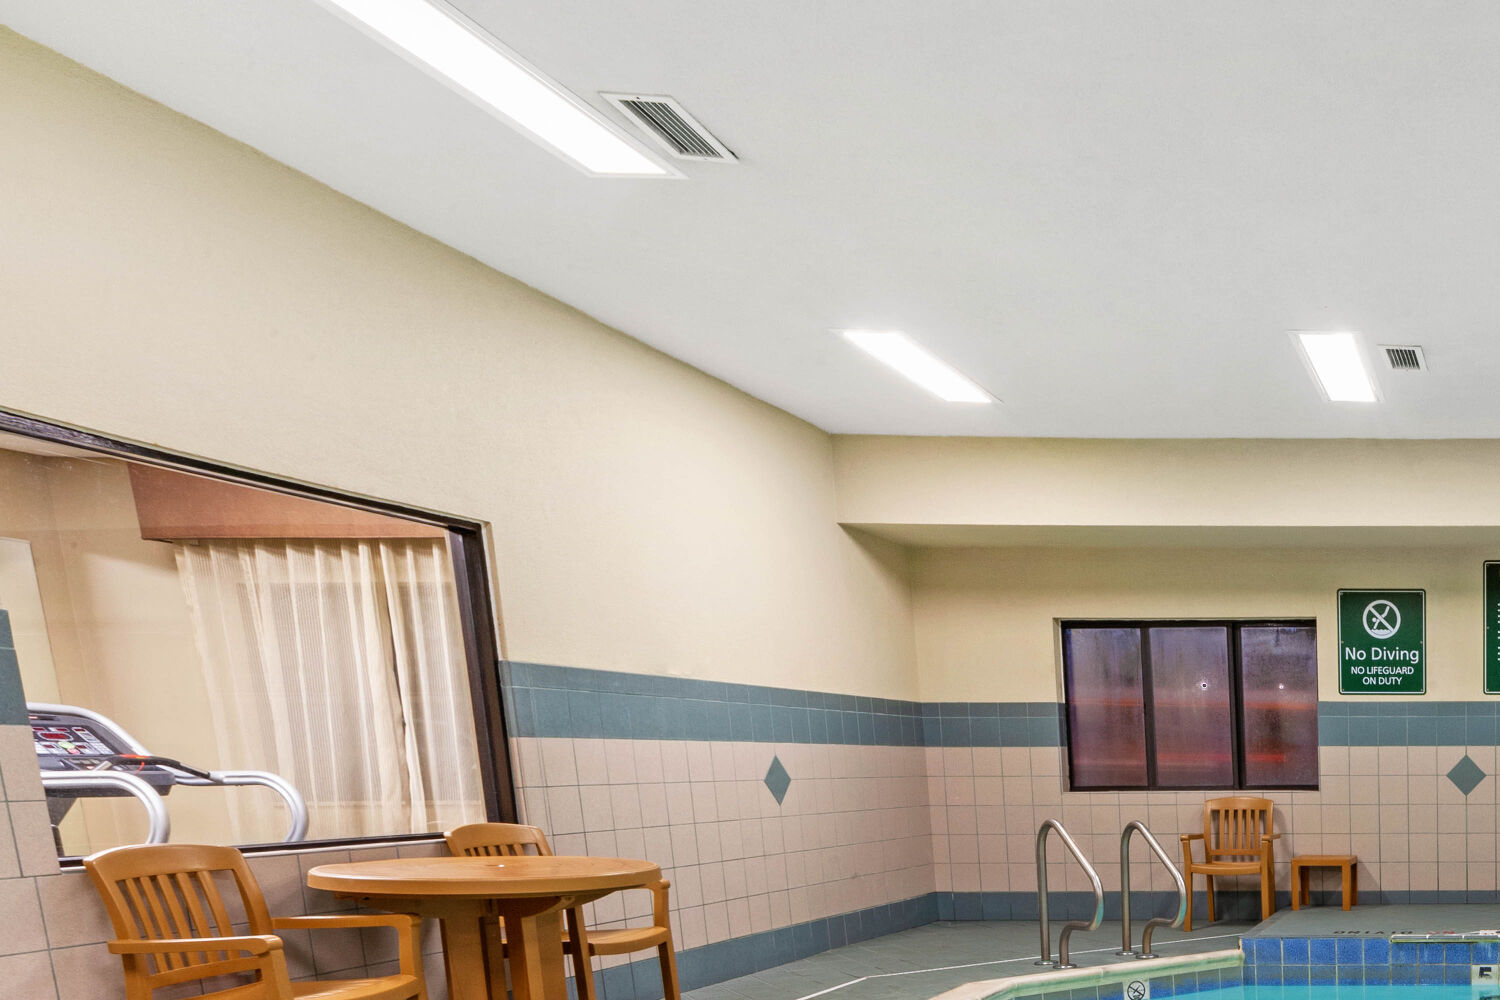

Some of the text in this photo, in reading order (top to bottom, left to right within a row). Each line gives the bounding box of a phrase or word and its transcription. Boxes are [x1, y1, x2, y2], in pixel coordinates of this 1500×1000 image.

[1345, 647, 1419, 664] No Diving
[1351, 666, 1414, 674] NO LIFEGUARD
[1362, 677, 1402, 685] ON DUTY
